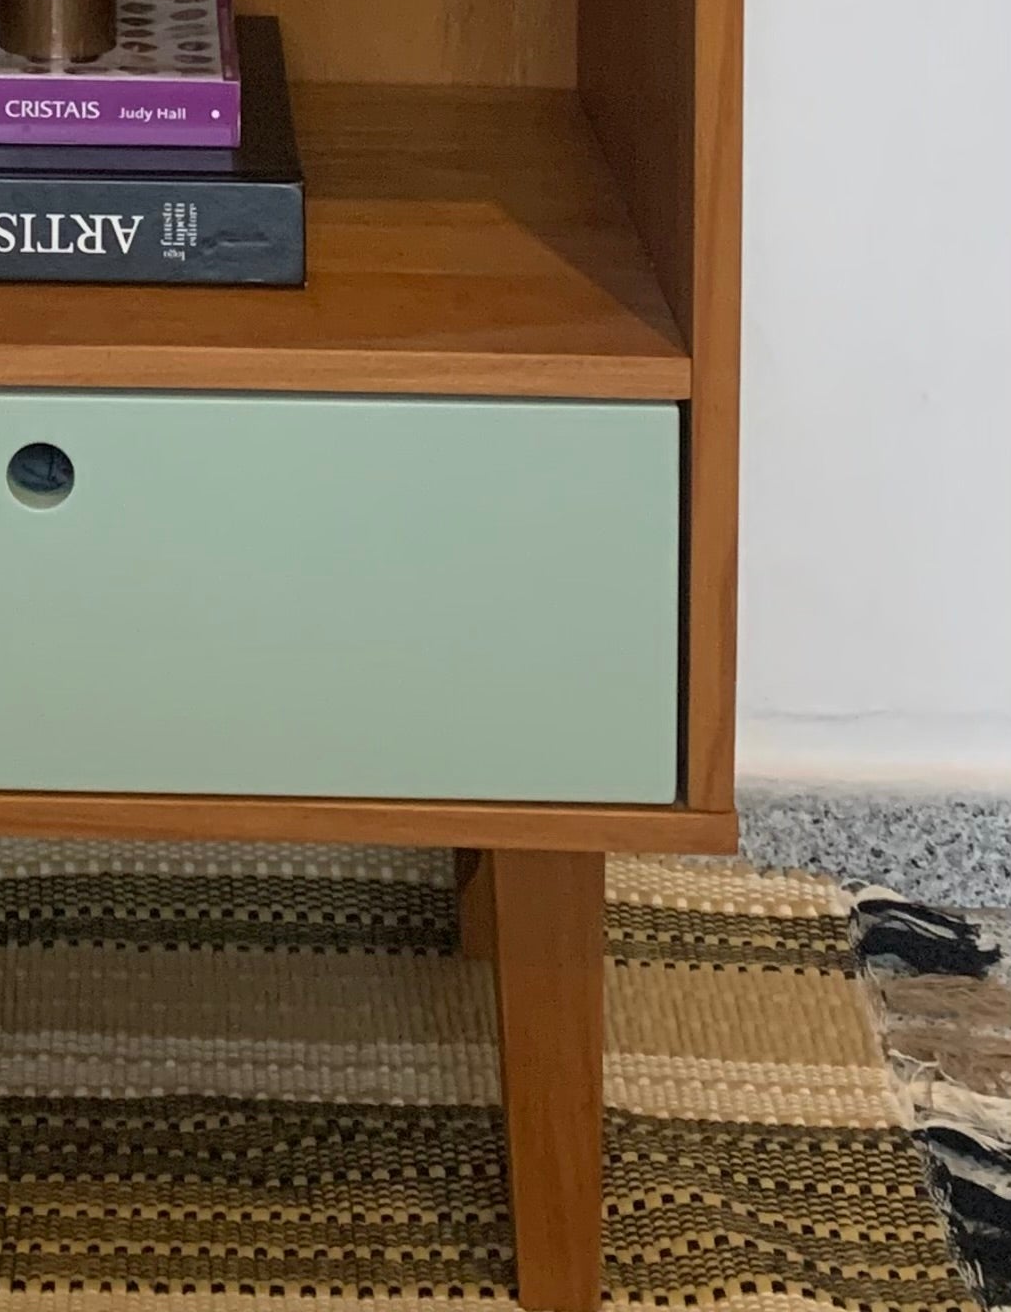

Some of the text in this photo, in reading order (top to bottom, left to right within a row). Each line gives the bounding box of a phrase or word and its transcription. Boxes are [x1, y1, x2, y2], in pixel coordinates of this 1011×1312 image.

[5, 99, 99, 119] CRISTAIS
[118, 105, 153, 122] Judy
[157, 105, 186, 121] Hall
[160, 202, 173, 246] fausto
[172, 203, 188, 246] lupetti
